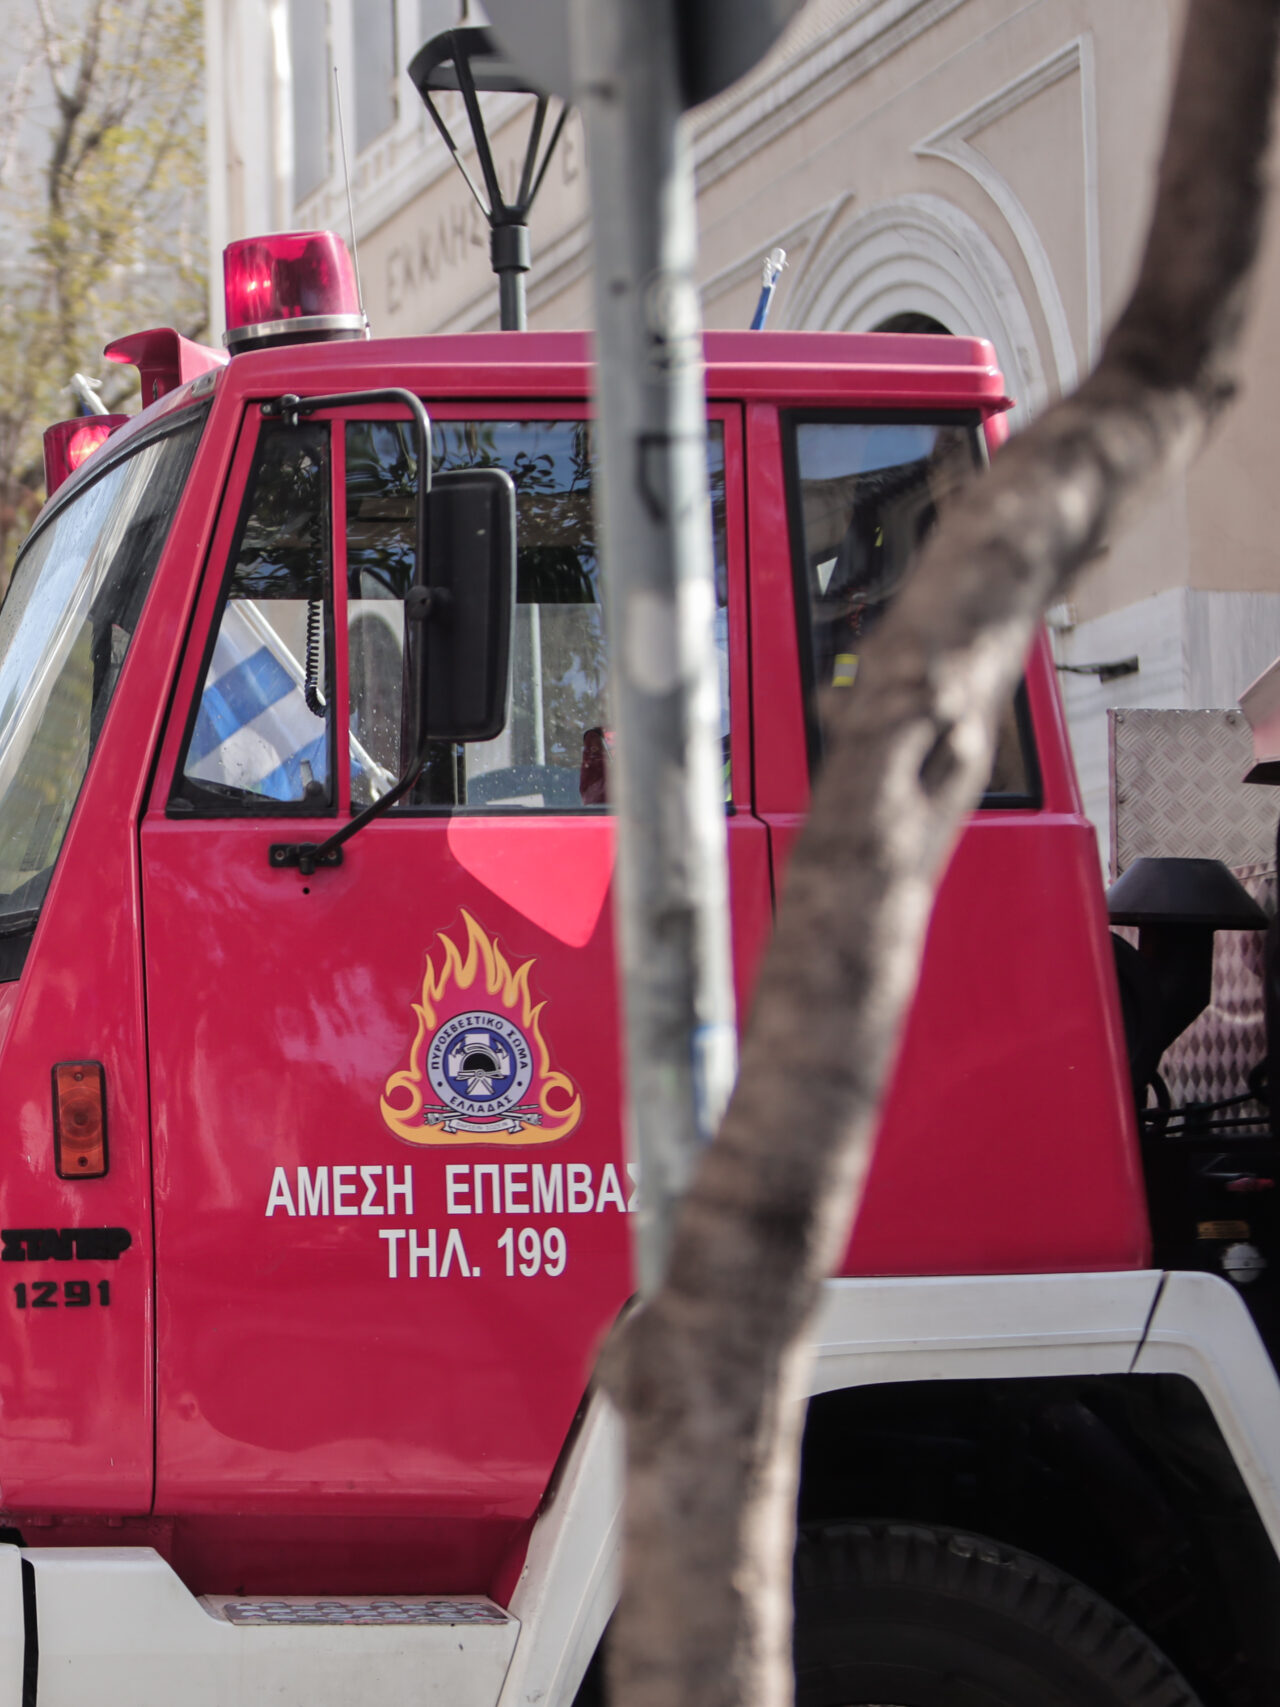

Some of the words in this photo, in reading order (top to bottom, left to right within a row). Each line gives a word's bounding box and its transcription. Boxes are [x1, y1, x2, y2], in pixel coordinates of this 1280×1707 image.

[431, 1015, 504, 1070] ΠΥΡΟΣΒΕΣΤΙΚΟ
[506, 1029, 528, 1069] ΣΩΜΑ
[449, 1094, 512, 1113] ΕΛΛΑΔΑΣ
[265, 1165, 414, 1217] ΑΜΕΣΗ
[378, 1228, 481, 1279] ΤΗΛ.
[497, 1227, 568, 1278] 199
[13, 1280, 110, 1309] 1291
